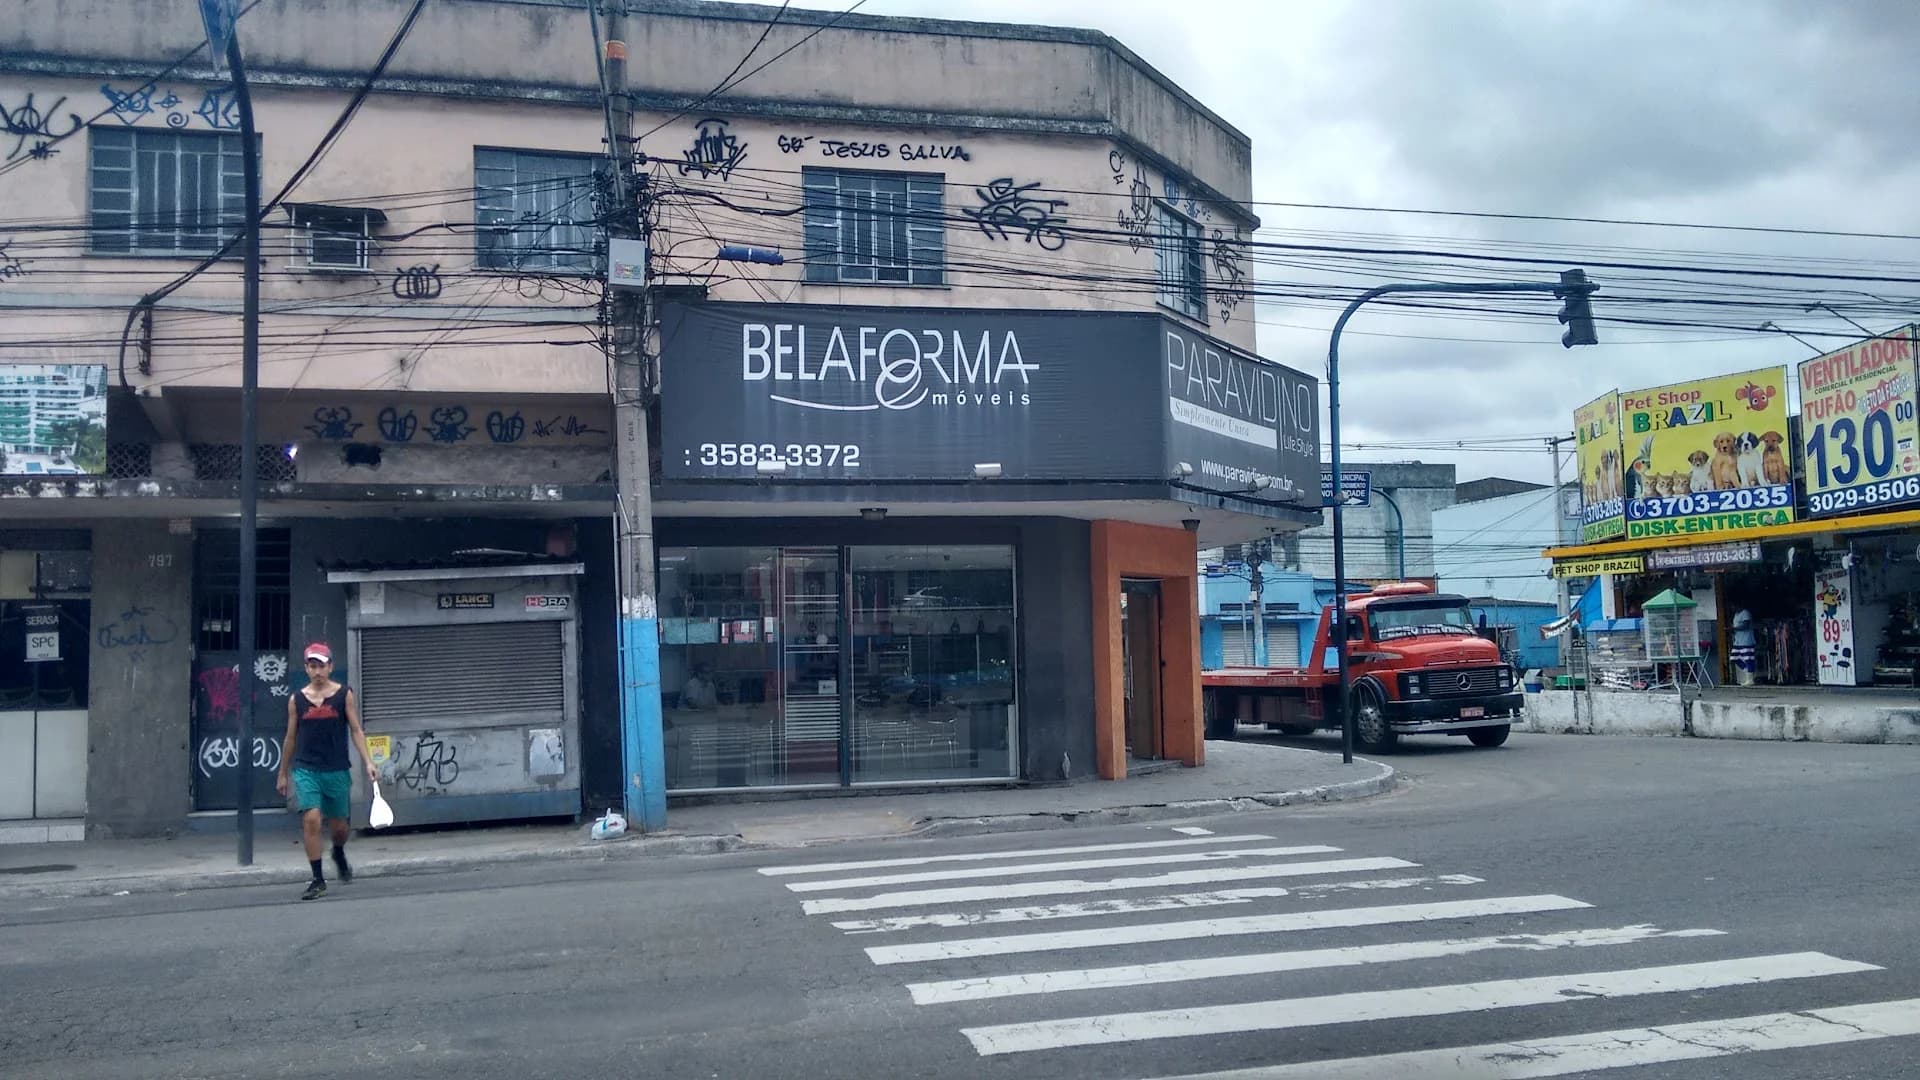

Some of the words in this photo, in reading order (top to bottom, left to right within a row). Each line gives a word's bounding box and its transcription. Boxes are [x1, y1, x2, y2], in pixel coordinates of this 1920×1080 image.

[742, 323, 1040, 385] BELAFORMA
[1802, 332, 1910, 390] VENTILADOR
[1167, 331, 1312, 434] PARAVIDINO
[932, 390, 1031, 406] móveis
[1624, 397, 1652, 411] Pet
[1658, 390, 1701, 406] Shop
[1804, 389, 1857, 422] TUFÃO
[1632, 400, 1733, 433] BRAZIL
[700, 444, 860, 467] 3583-3372
[1806, 409, 1894, 489] 130
[1647, 486, 1789, 517] 3703-2035
[1809, 477, 1920, 512] 3029-8506
[1630, 510, 1790, 538] DISK-ENTREGA
[148, 554, 173, 567] 797
[1575, 563, 1601, 573] SHOP
[1603, 559, 1640, 571] BRAZIL
[455, 595, 489, 603] LANCE
[25, 615, 59, 625] SERASA
[1823, 620, 1841, 643] 89
[32, 636, 55, 648] SPC
